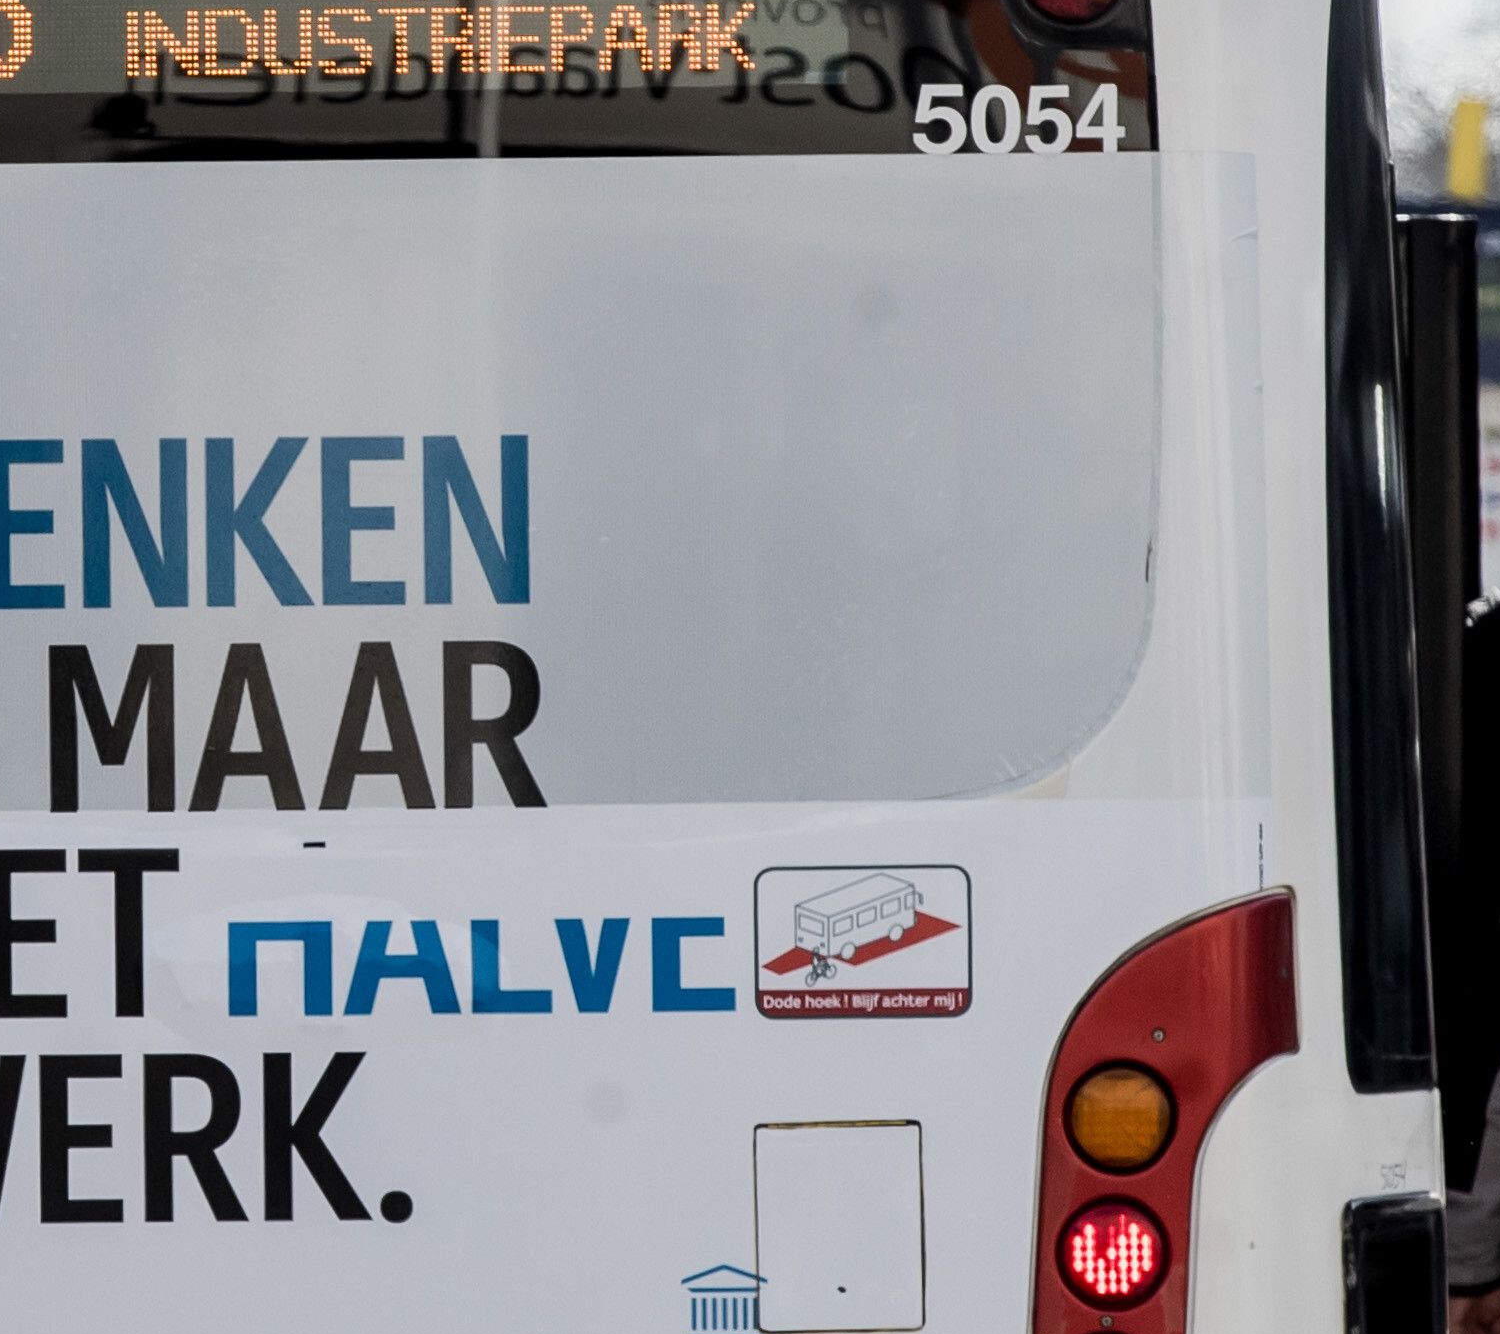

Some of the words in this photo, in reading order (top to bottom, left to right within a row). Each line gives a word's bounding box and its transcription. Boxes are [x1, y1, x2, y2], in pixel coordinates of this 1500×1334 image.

[126, 2, 756, 77] INDUSTRIEPARK
[912, 82, 1126, 155] 5054
[48, 640, 548, 813] MAAR
[762, 994, 802, 1009] Dode
[805, 994, 843, 1008] hoek
[852, 993, 881, 1012] Blijf
[882, 992, 930, 1008] achter
[934, 992, 956, 1011] mij
